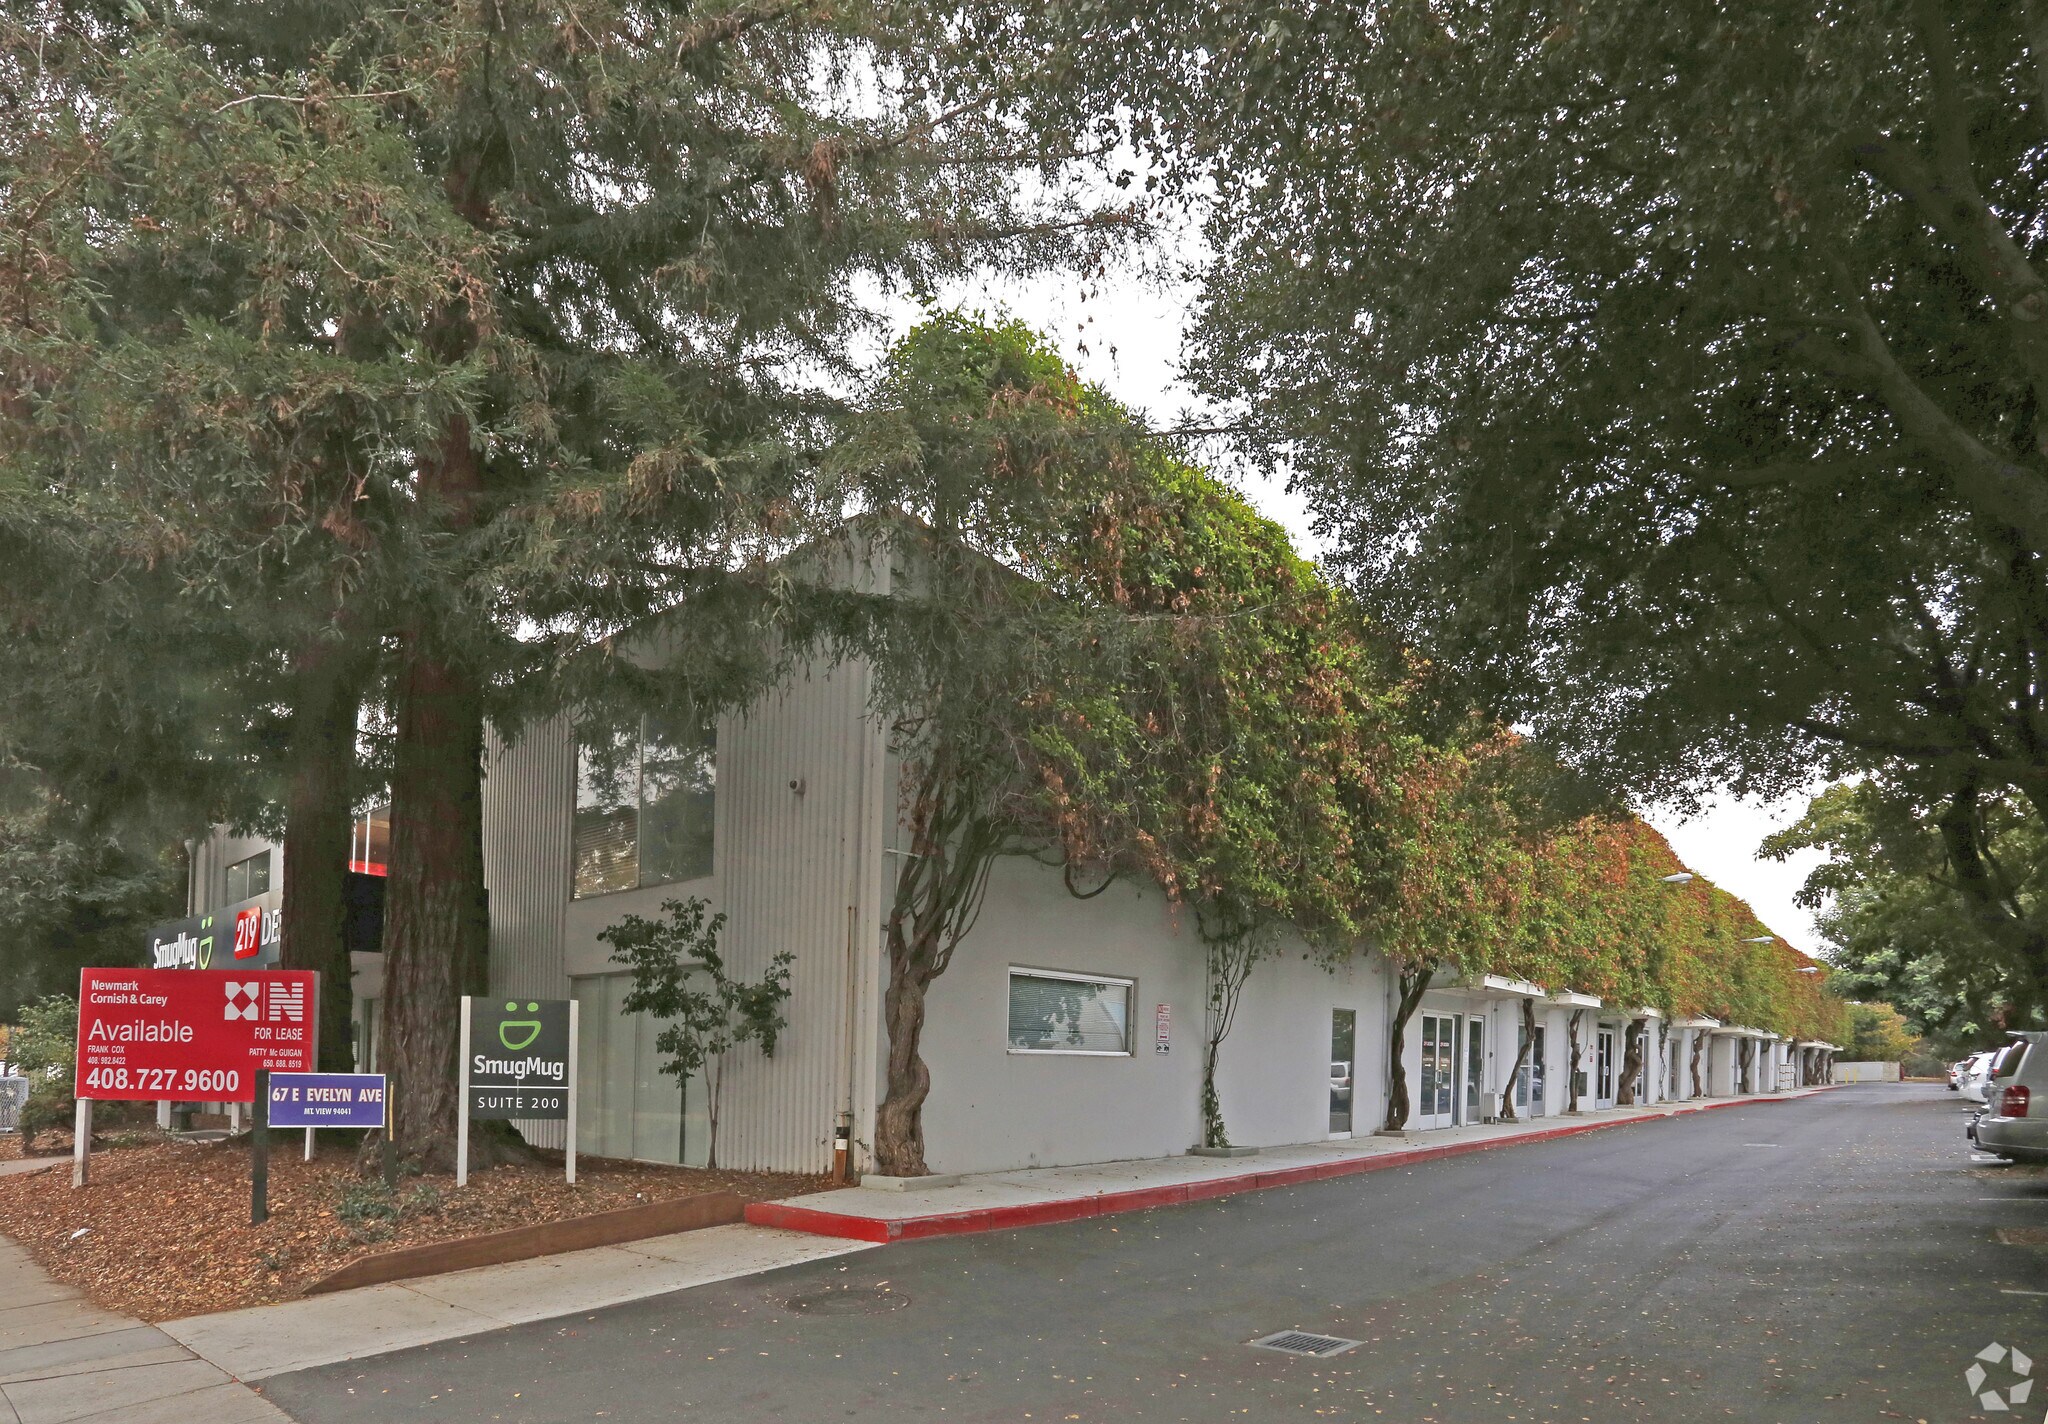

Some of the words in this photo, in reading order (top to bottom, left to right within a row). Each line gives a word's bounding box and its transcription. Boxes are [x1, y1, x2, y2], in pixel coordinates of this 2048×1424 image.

[235, 915, 257, 952] 219
[261, 908, 282, 946] DE
[153, 932, 198, 969] SmugMug
[91, 980, 139, 991] Newmark
[90, 993, 128, 1004] Cornish
[130, 994, 138, 1004] &
[140, 994, 168, 1007] Carey
[88, 1018, 194, 1043] Available
[254, 1027, 272, 1040] FOR
[275, 1028, 303, 1041] LEASE
[87, 1045, 109, 1053] FRANK
[111, 1045, 125, 1054] COX
[249, 1048, 267, 1056] PATTY
[279, 1048, 303, 1057] GUIGAN
[473, 1054, 564, 1081] SmugMug
[86, 1067, 239, 1092] 408.727.9600
[271, 1087, 289, 1102] 67
[292, 1087, 300, 1102] E
[306, 1087, 352, 1102] EVELYN
[358, 1088, 382, 1103] AVE
[477, 1096, 523, 1109] SUITE
[531, 1097, 559, 1109] 200
[315, 1107, 332, 1115] VIEW
[332, 1107, 352, 1115] 94041
